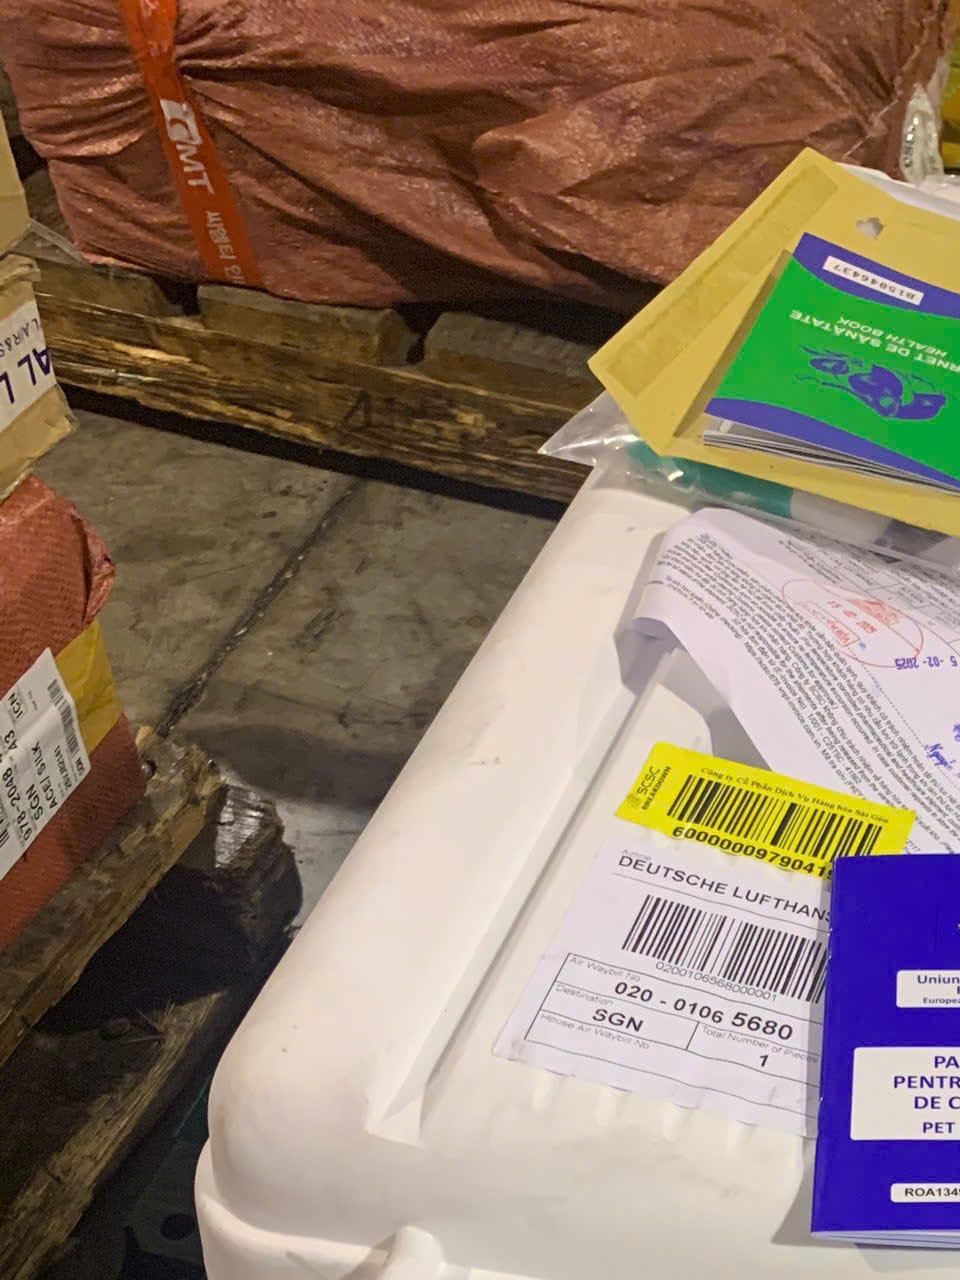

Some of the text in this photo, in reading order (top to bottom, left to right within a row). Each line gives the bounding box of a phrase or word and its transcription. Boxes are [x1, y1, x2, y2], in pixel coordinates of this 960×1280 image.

[838, 317, 948, 358] HEALTH BOOK
[886, 343, 911, 357] DE
[8, 691, 24, 720] ICN
[31, 741, 47, 776] SILK
[636, 766, 661, 795] SCSC
[26, 784, 43, 820] SGN
[618, 856, 729, 894] DEUTSCHE
[569, 956, 641, 982] Air Waybill No
[655, 961, 777, 1002] 0200106568000001
[555, 984, 613, 1007] Destination
[592, 1008, 645, 1033] SGN
[614, 981, 653, 1002] 020
[673, 998, 724, 1024] 0106
[731, 1011, 793, 1041] 5680
[540, 1014, 575, 1030] House
[577, 1023, 592, 1033] Air
[594, 1027, 634, 1048] Waybill
[702, 1026, 726, 1039] Total
[727, 1031, 769, 1050] Number
[771, 1045, 783, 1054] of
[759, 1055, 769, 1068] 1
[914, 1095, 941, 1110] DE
[922, 1121, 955, 1134] PET
